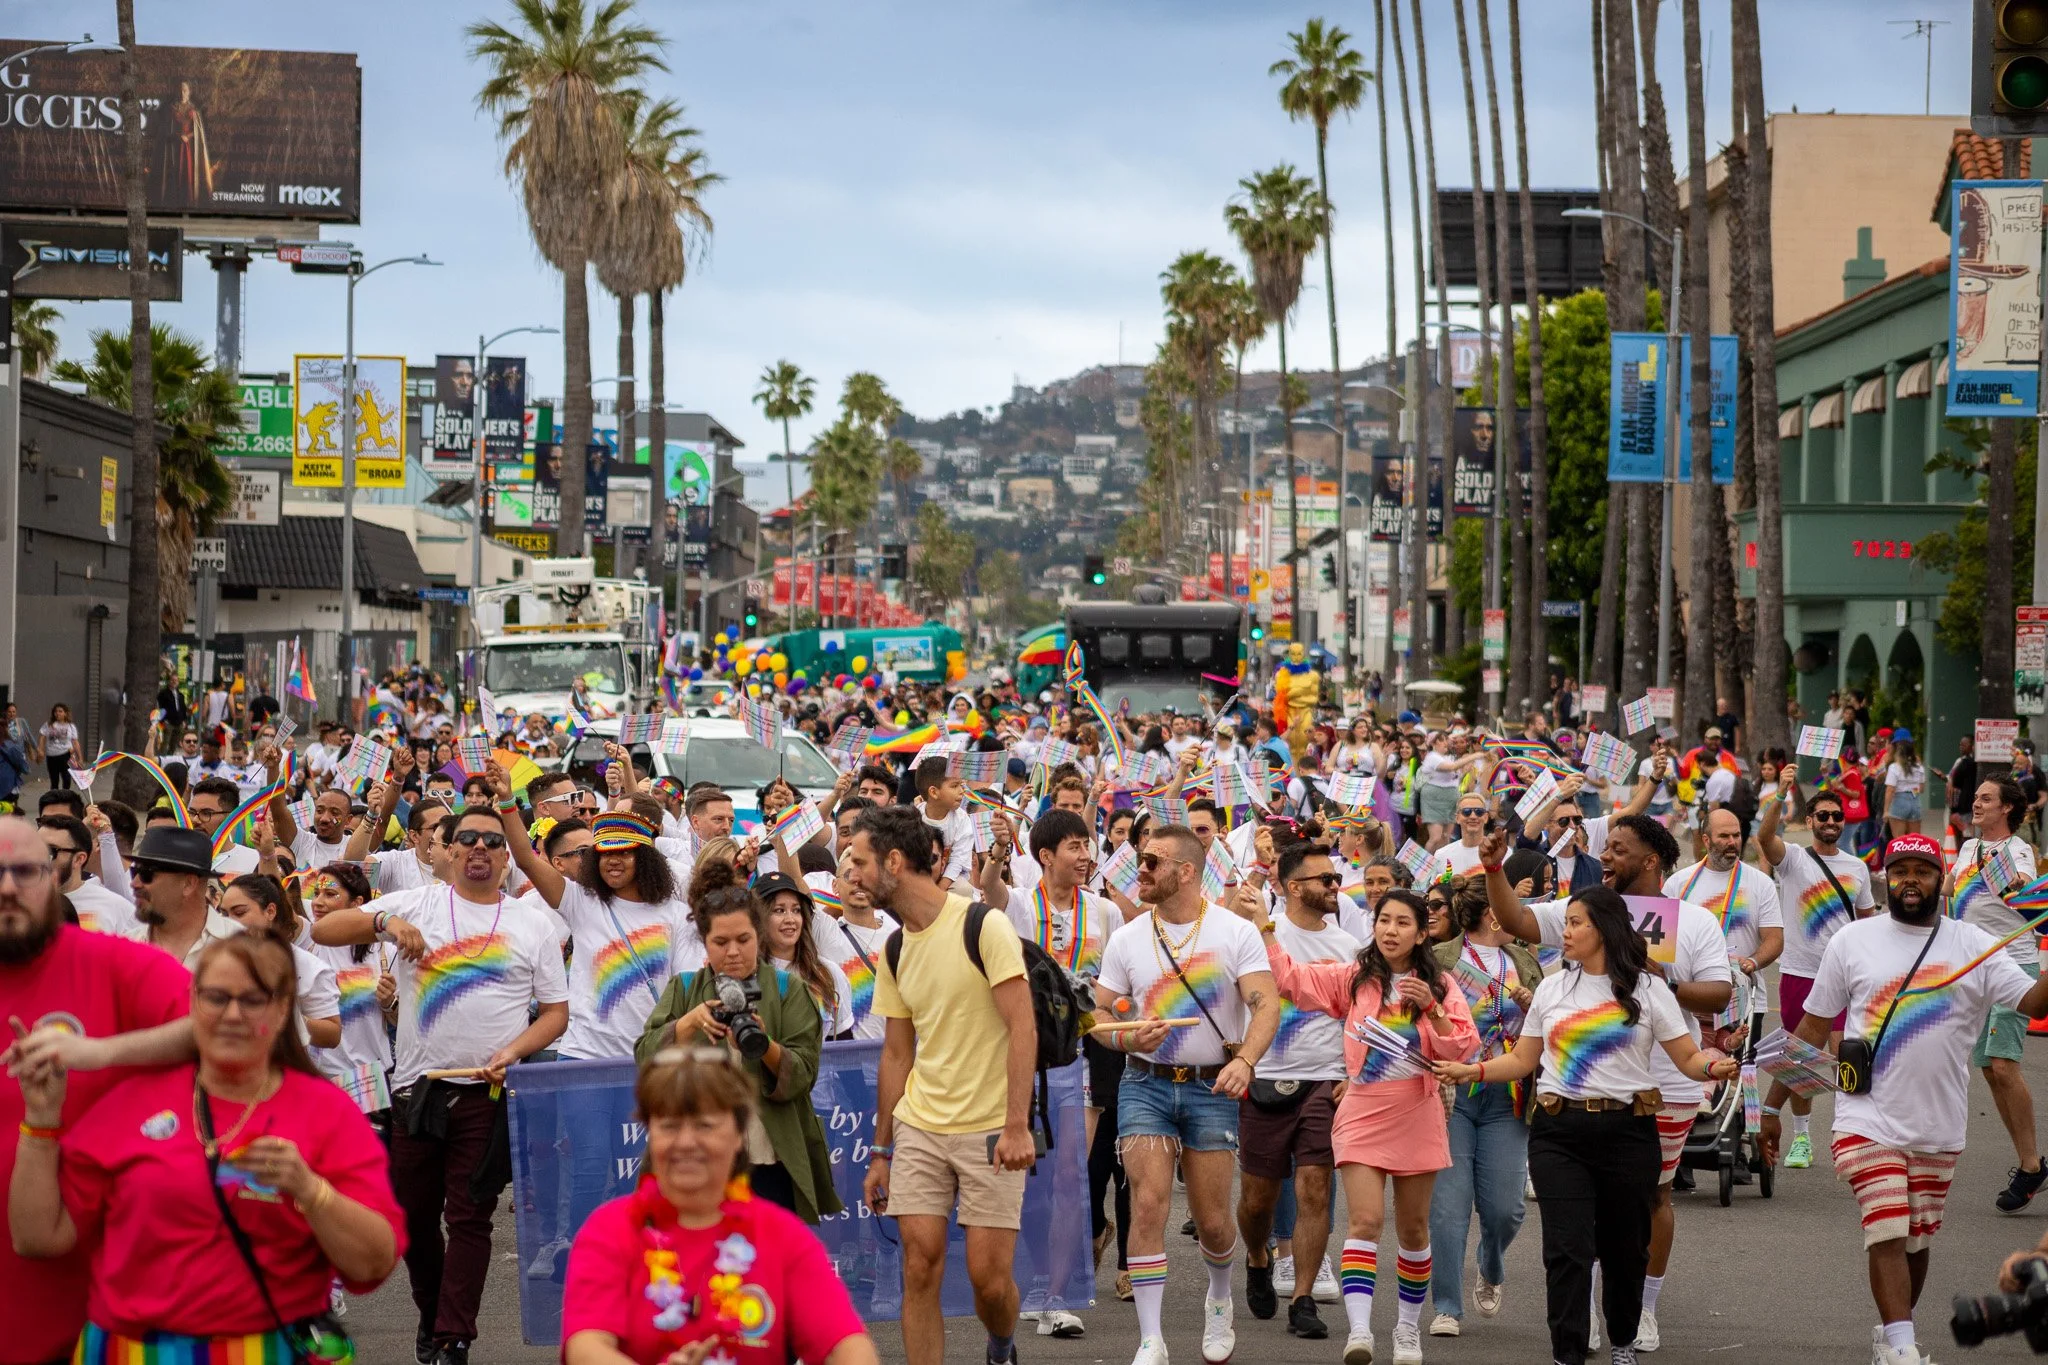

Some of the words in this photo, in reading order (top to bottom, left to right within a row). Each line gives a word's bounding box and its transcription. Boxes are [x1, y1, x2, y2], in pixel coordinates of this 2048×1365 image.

[212, 192, 265, 203] STREAMING
[279, 184, 342, 206] max
[240, 183, 266, 193] NOW
[280, 250, 300, 261] BIG
[302, 251, 349, 262] OUTDOOR
[117, 264, 169, 272] CARA
[1956, 383, 2014, 394] JEAN-MICHEL
[1955, 393, 1999, 405] BASQUIAT
[436, 401, 447, 418] A
[1620, 361, 1639, 454] JEAN-MICHEL
[434, 434, 471, 450] PLAY
[303, 463, 332, 471] KEITH
[1455, 455, 1466, 471] A
[368, 469, 402, 479] BROAD
[1454, 488, 1489, 504] PLAY
[1371, 520, 1401, 534] PLAY
[1851, 540, 1913, 559] 7023
[1976, 731, 1991, 742] NO
[1892, 841, 1936, 855] Rockets
[829, 1104, 863, 1137] by
